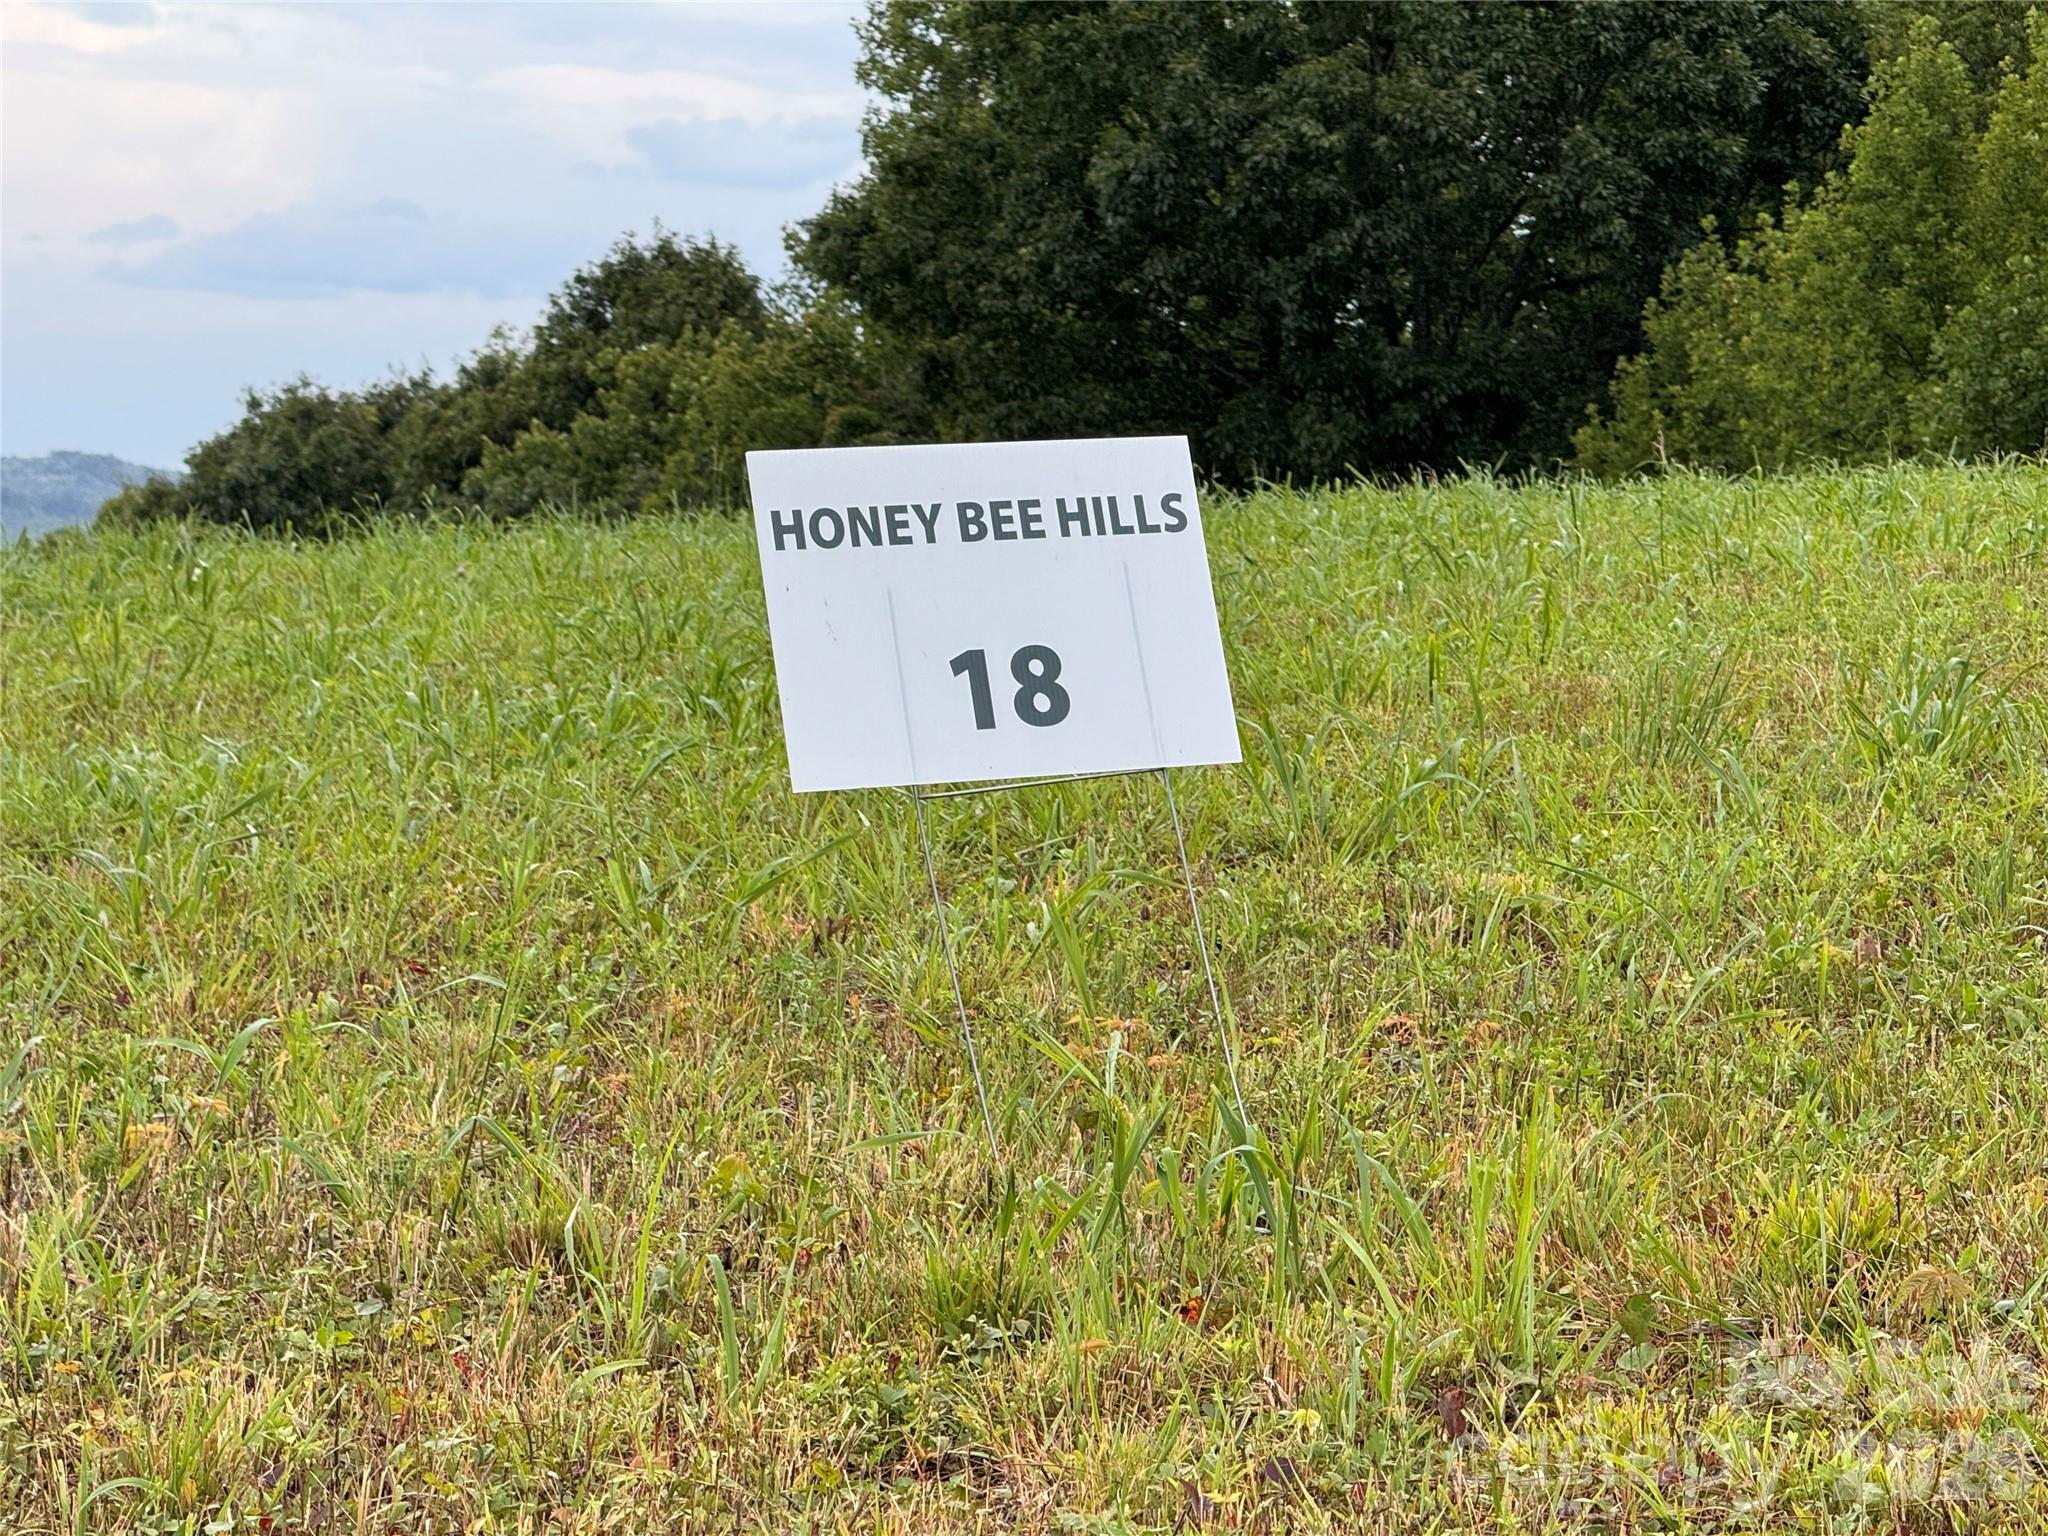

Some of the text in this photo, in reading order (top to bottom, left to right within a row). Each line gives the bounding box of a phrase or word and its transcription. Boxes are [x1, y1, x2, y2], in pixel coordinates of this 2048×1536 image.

[770, 492, 1188, 551] HONEY BEE HILLS
[949, 644, 1071, 731] 18
